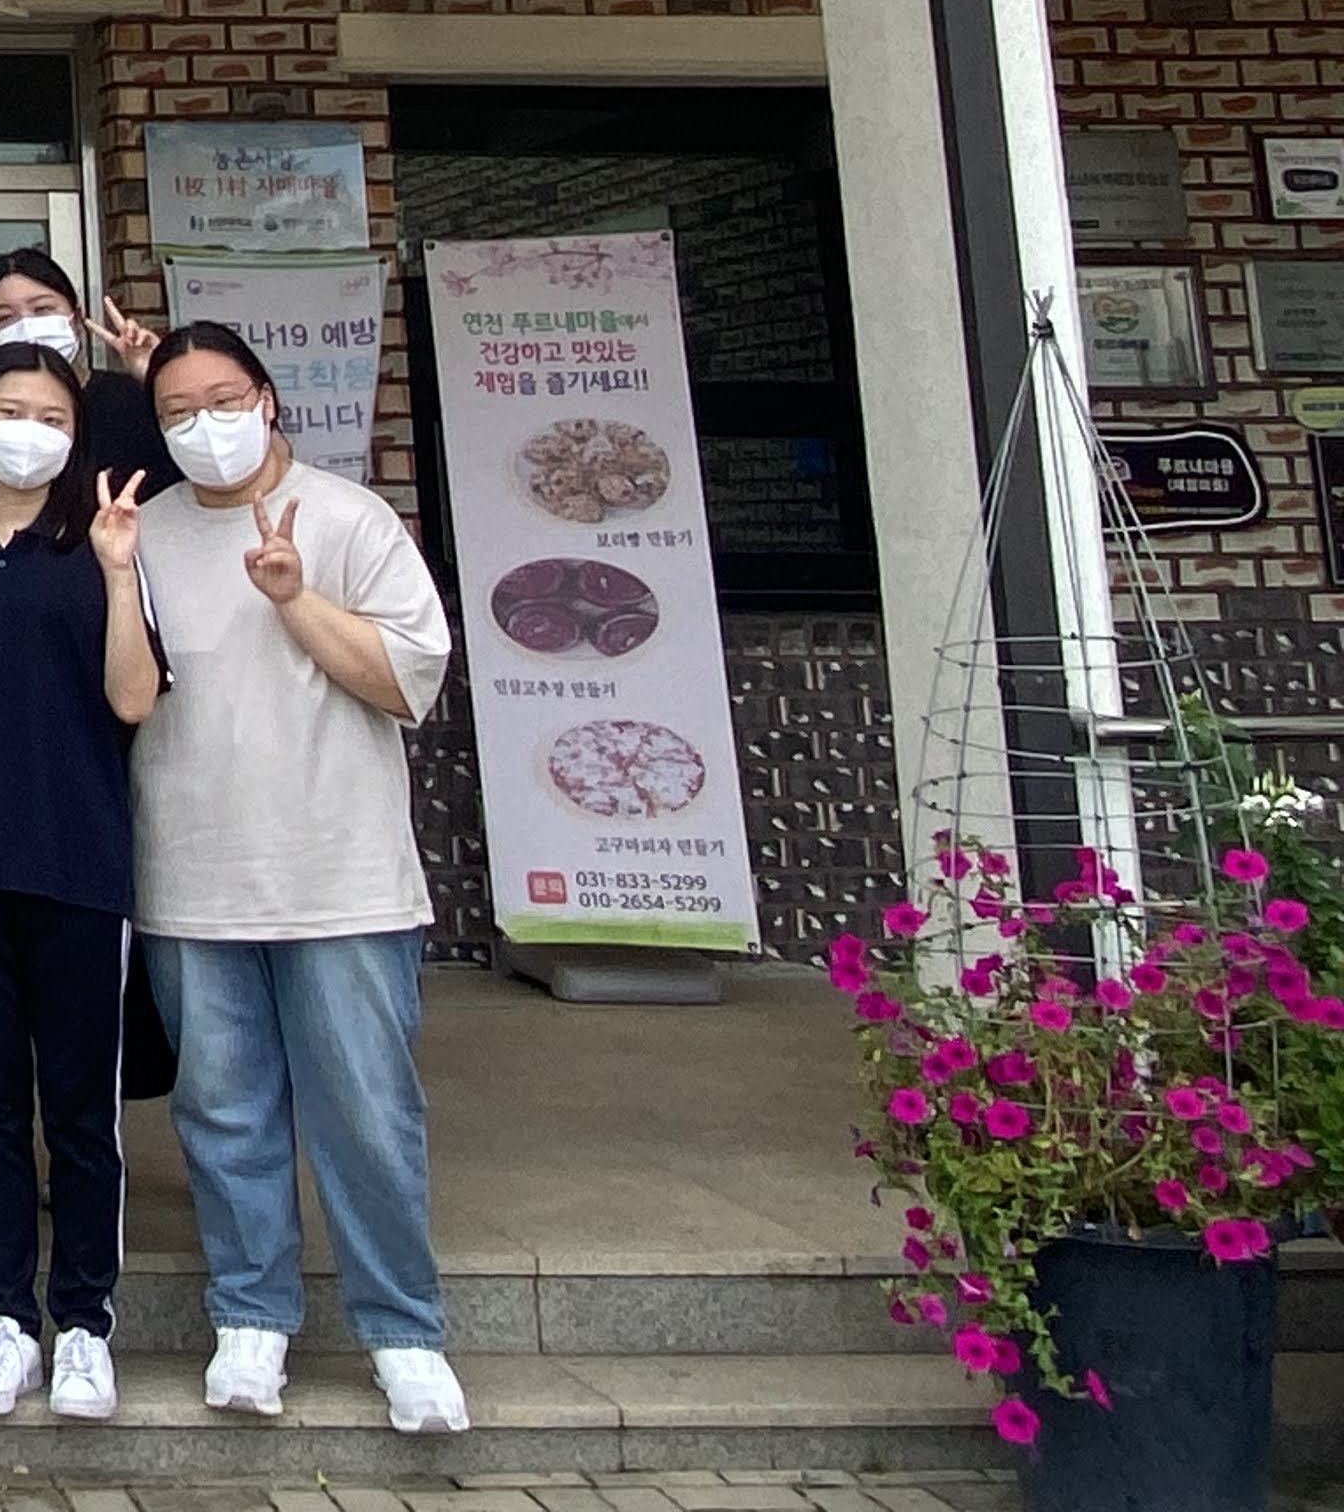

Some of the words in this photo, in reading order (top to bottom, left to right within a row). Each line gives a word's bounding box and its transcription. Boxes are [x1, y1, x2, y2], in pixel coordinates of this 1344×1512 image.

[224, 320, 309, 350] 나19
[321, 316, 377, 349] 예방
[462, 311, 505, 336] 연천
[479, 339, 566, 365] 건강하고
[571, 337, 637, 363] 맛있는
[473, 368, 537, 396] 체험을
[546, 367, 650, 396] 즐기세요!!
[279, 400, 366, 435] 입니다
[594, 836, 673, 857] 고구마피자
[677, 837, 725, 857] 만들기
[575, 870, 708, 892] 031-833-5299
[578, 893, 723, 914] 010-2654-5299
